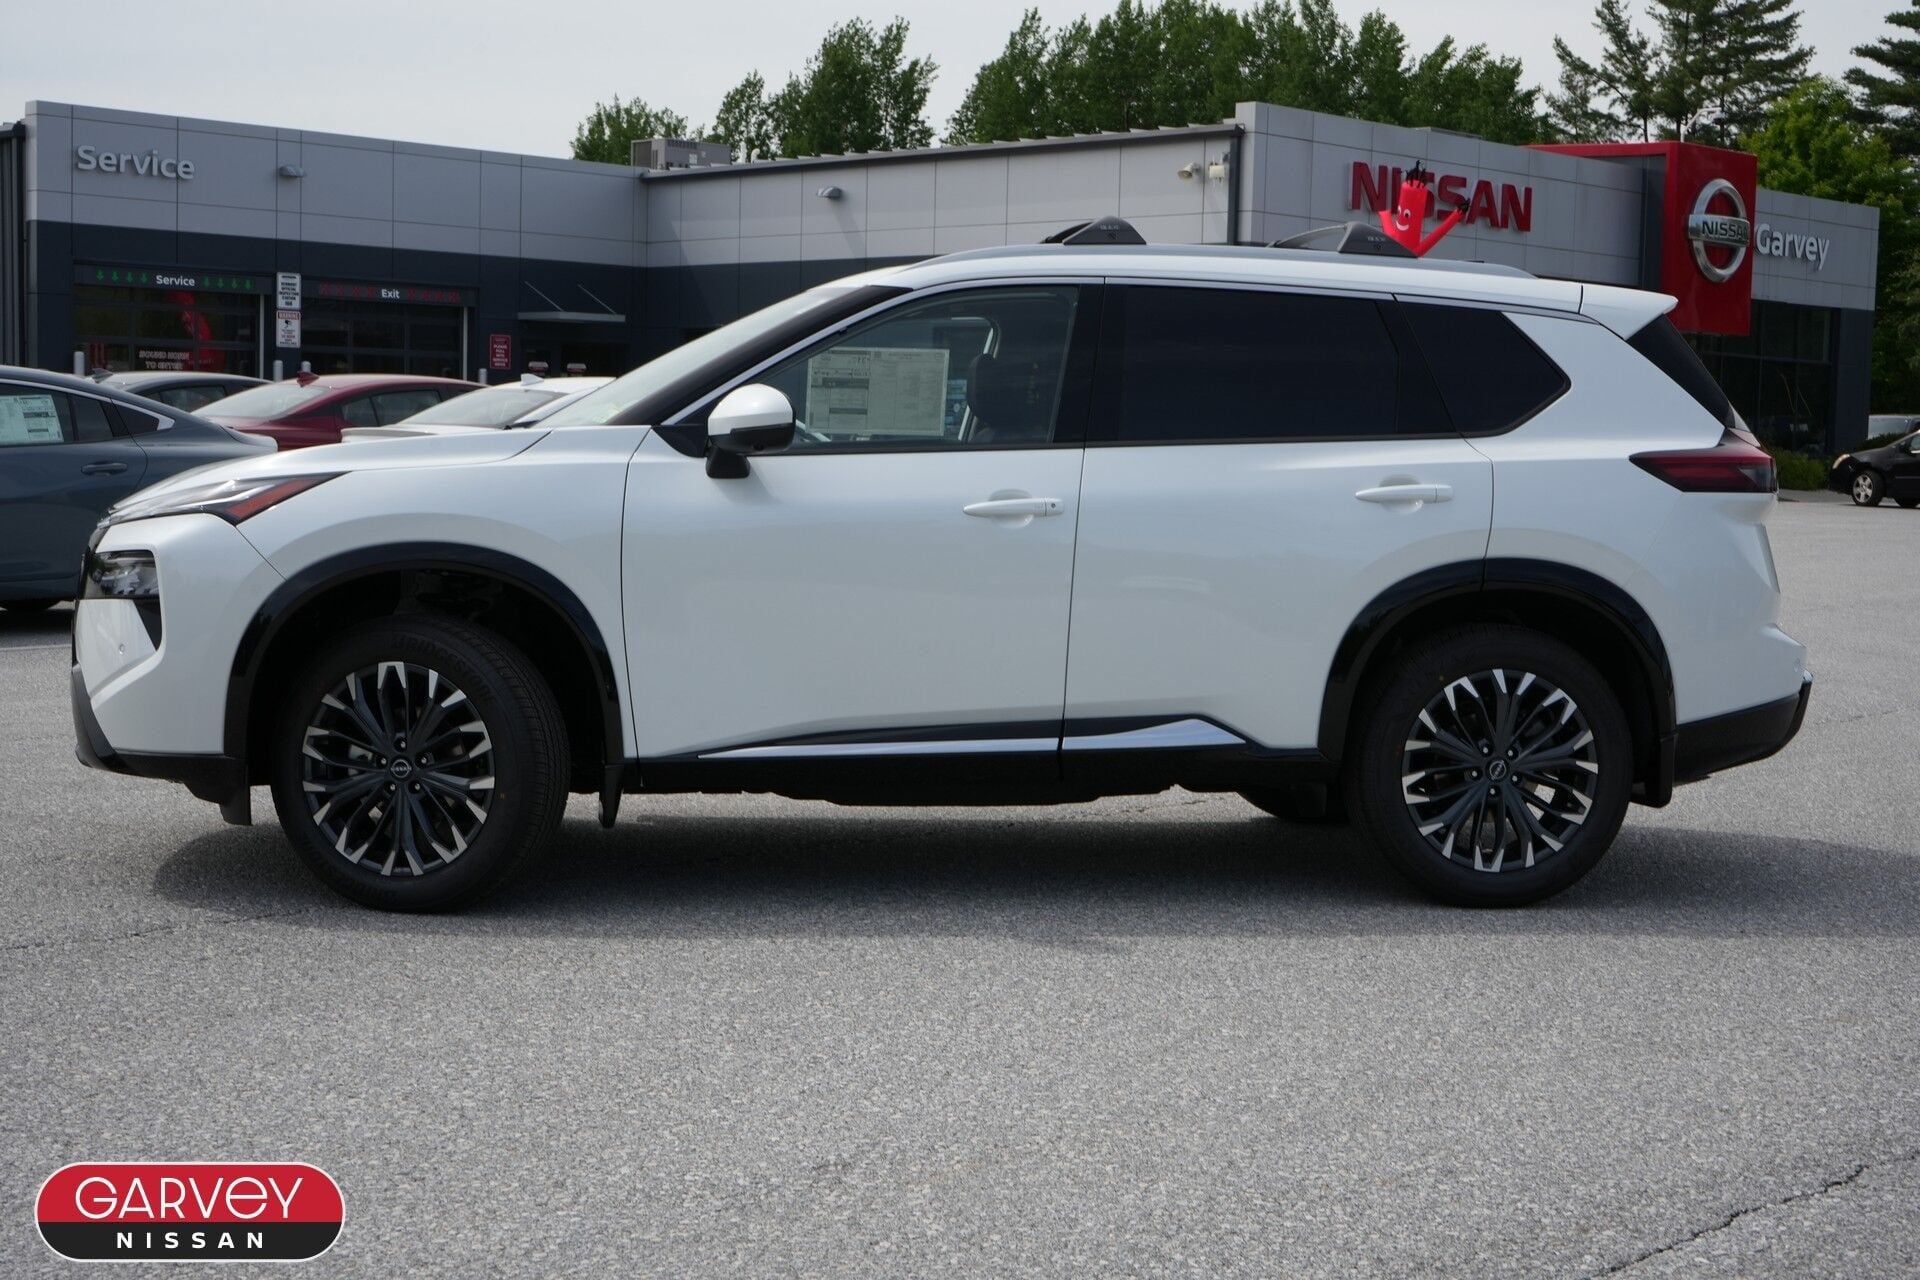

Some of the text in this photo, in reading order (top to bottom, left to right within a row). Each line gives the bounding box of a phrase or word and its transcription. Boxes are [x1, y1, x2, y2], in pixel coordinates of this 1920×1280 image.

[77, 145, 195, 180] Service
[1756, 223, 1830, 271] Garvey
[156, 274, 196, 287] Service
[381, 288, 400, 299] Exit
